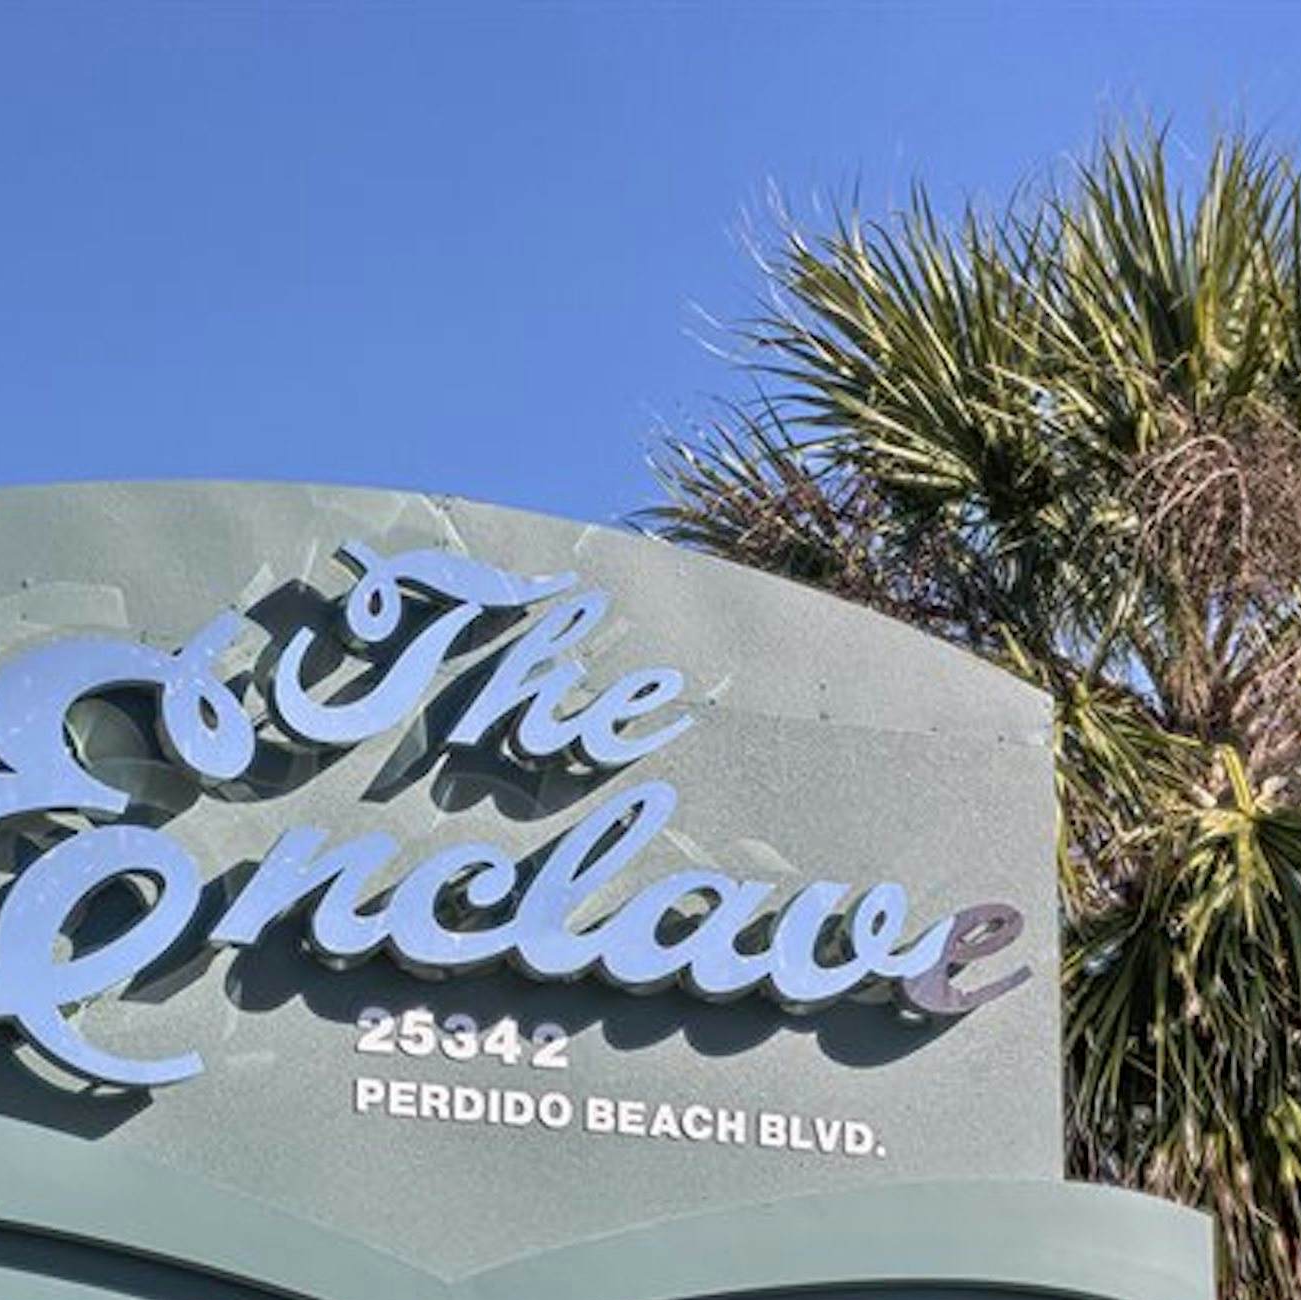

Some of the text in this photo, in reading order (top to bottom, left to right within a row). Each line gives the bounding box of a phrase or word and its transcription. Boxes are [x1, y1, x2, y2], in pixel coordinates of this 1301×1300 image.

[275, 540, 694, 769] The
[356, 1006, 570, 1068] 25342
[355, 1078, 887, 1157] PERDIDO BEACH BLVD.
